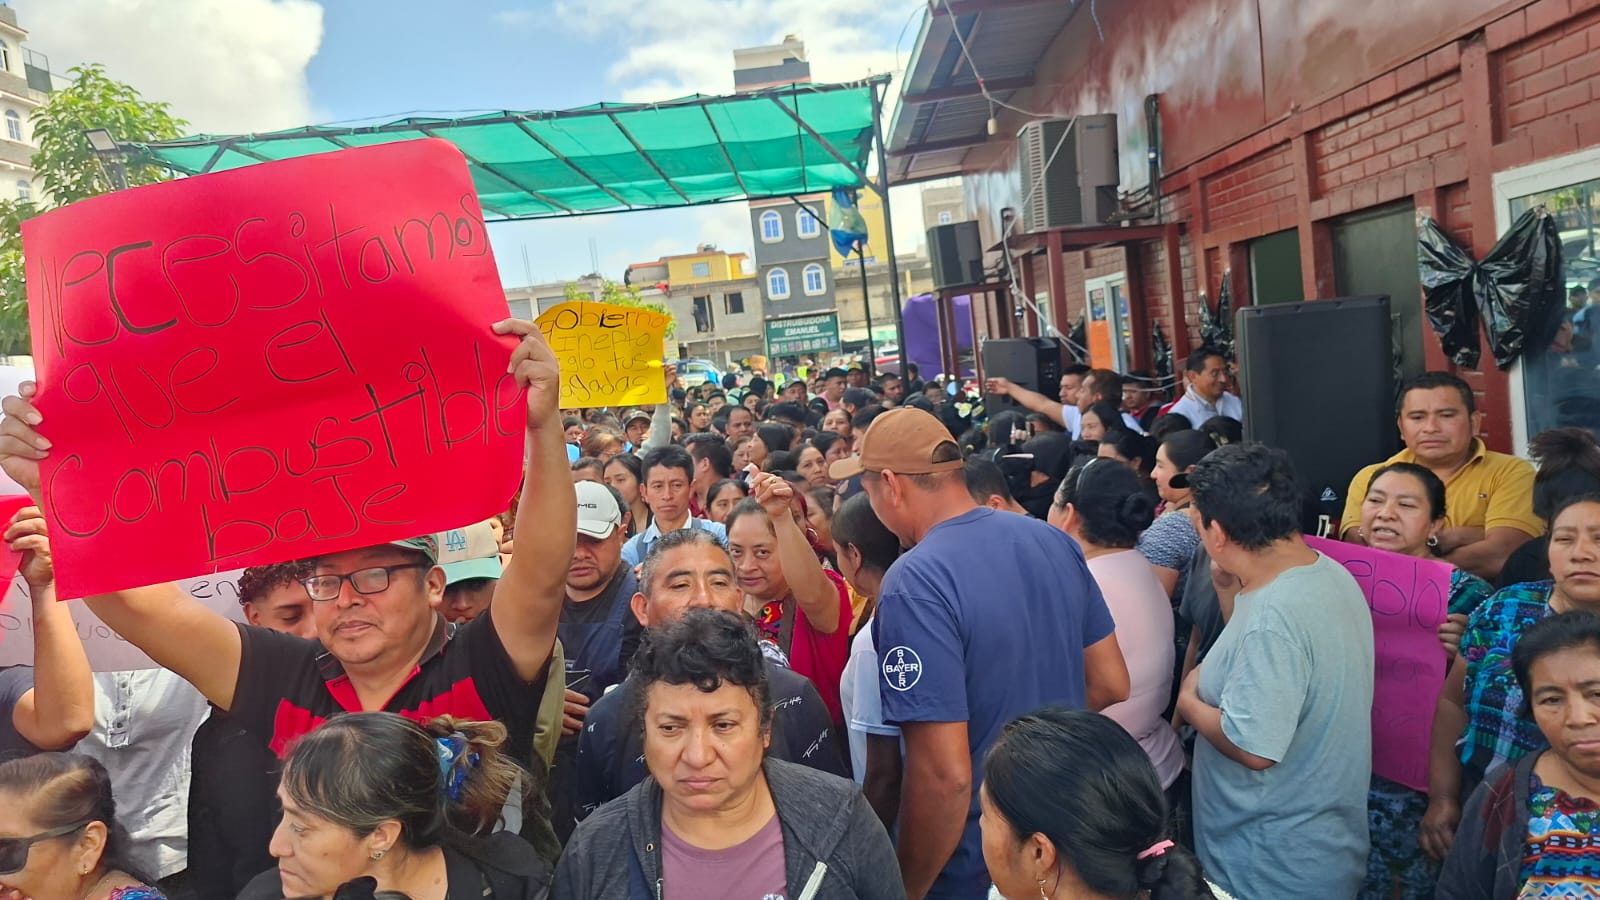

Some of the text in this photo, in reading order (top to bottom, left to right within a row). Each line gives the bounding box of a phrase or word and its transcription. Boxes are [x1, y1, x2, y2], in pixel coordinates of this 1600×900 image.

[785, 325, 820, 336] EMANUEL
[264, 308, 357, 383] el
[444, 529, 466, 552] LA
[886, 663, 919, 673] BAYER
